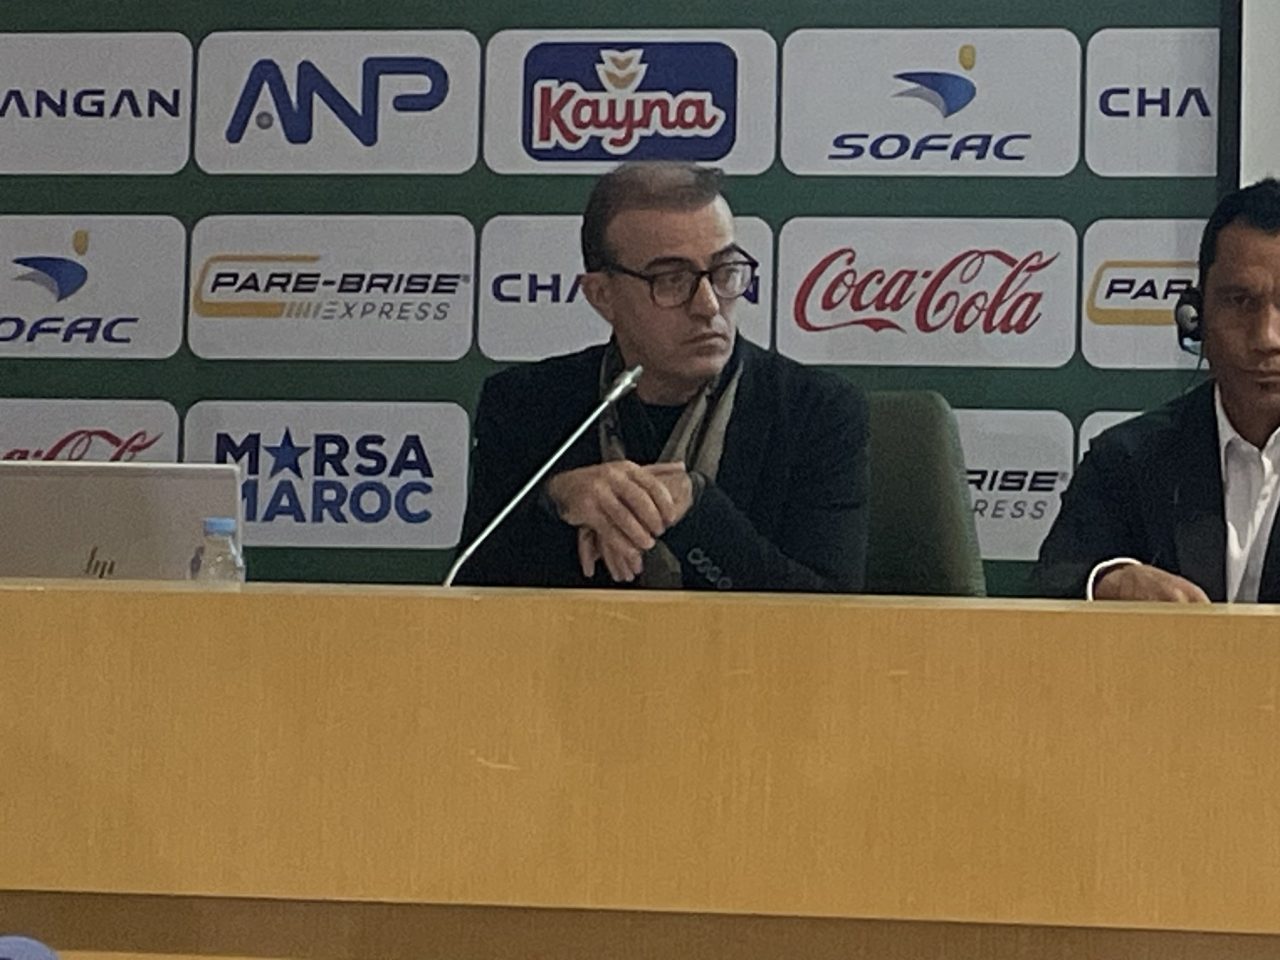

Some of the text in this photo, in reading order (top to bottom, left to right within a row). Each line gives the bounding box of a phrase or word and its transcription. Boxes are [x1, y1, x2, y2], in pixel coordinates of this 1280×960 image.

[226, 57, 449, 147] ANP
[538, 86, 718, 147] Kayna
[828, 134, 1031, 160] SOFAC
[210, 272, 461, 294] PARE-BRISE
[794, 248, 1059, 334] Coca-Cola
[321, 301, 451, 321] EXPRESS
